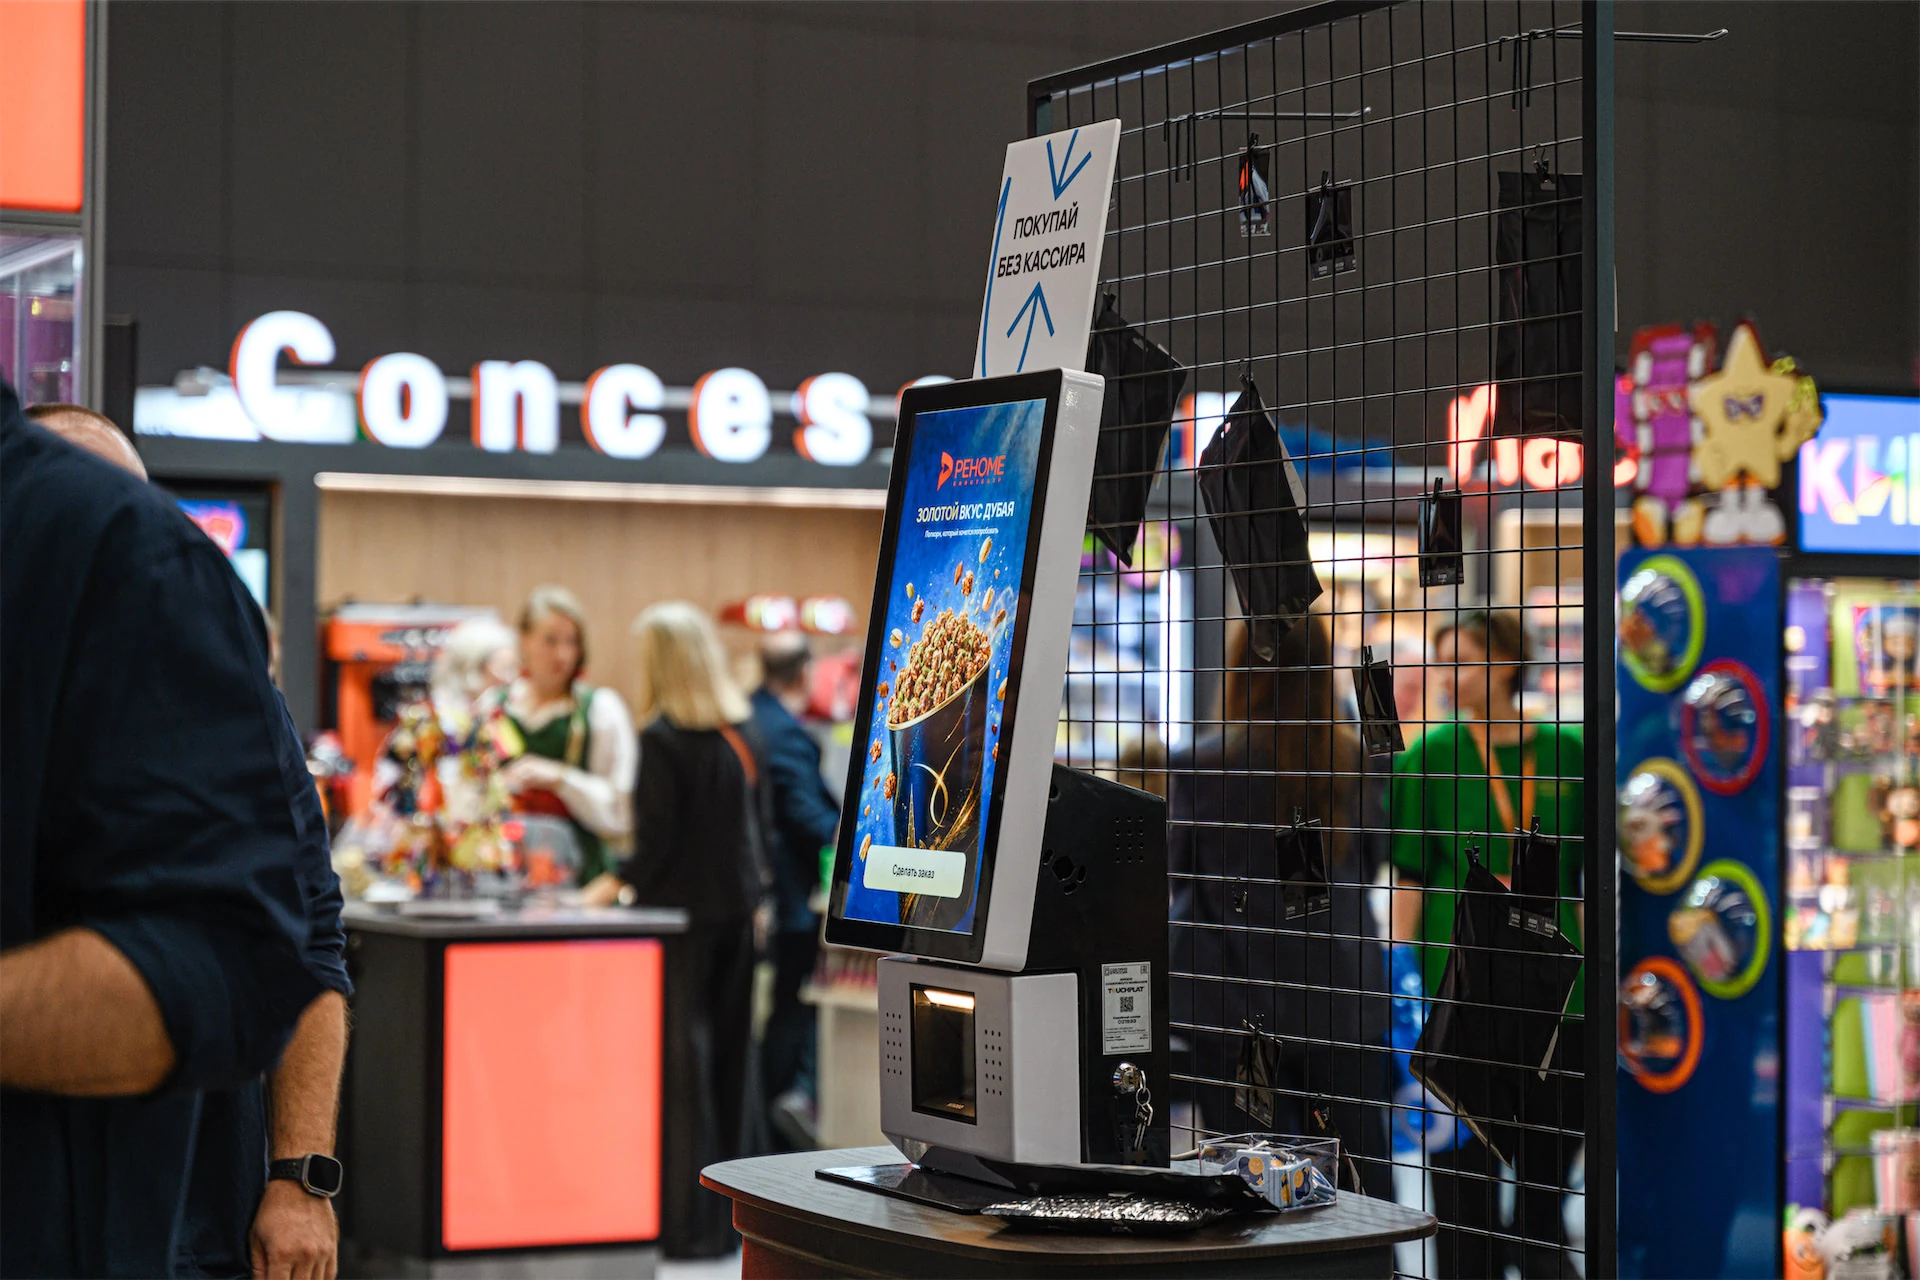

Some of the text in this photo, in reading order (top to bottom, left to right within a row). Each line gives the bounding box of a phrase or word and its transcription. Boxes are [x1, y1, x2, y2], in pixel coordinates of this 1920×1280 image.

[1013, 201, 1079, 240] ПОКУПАЙ
[997, 242, 1085, 278] БЕЗ КАССИРА
[229, 311, 956, 467] Conces
[953, 455, 1006, 479] РЕНОМЕ
[916, 501, 1015, 523] ЗОЛОТОЙ ВКУС ДУБАЯ
[892, 864, 935, 879] Сделать заказ
